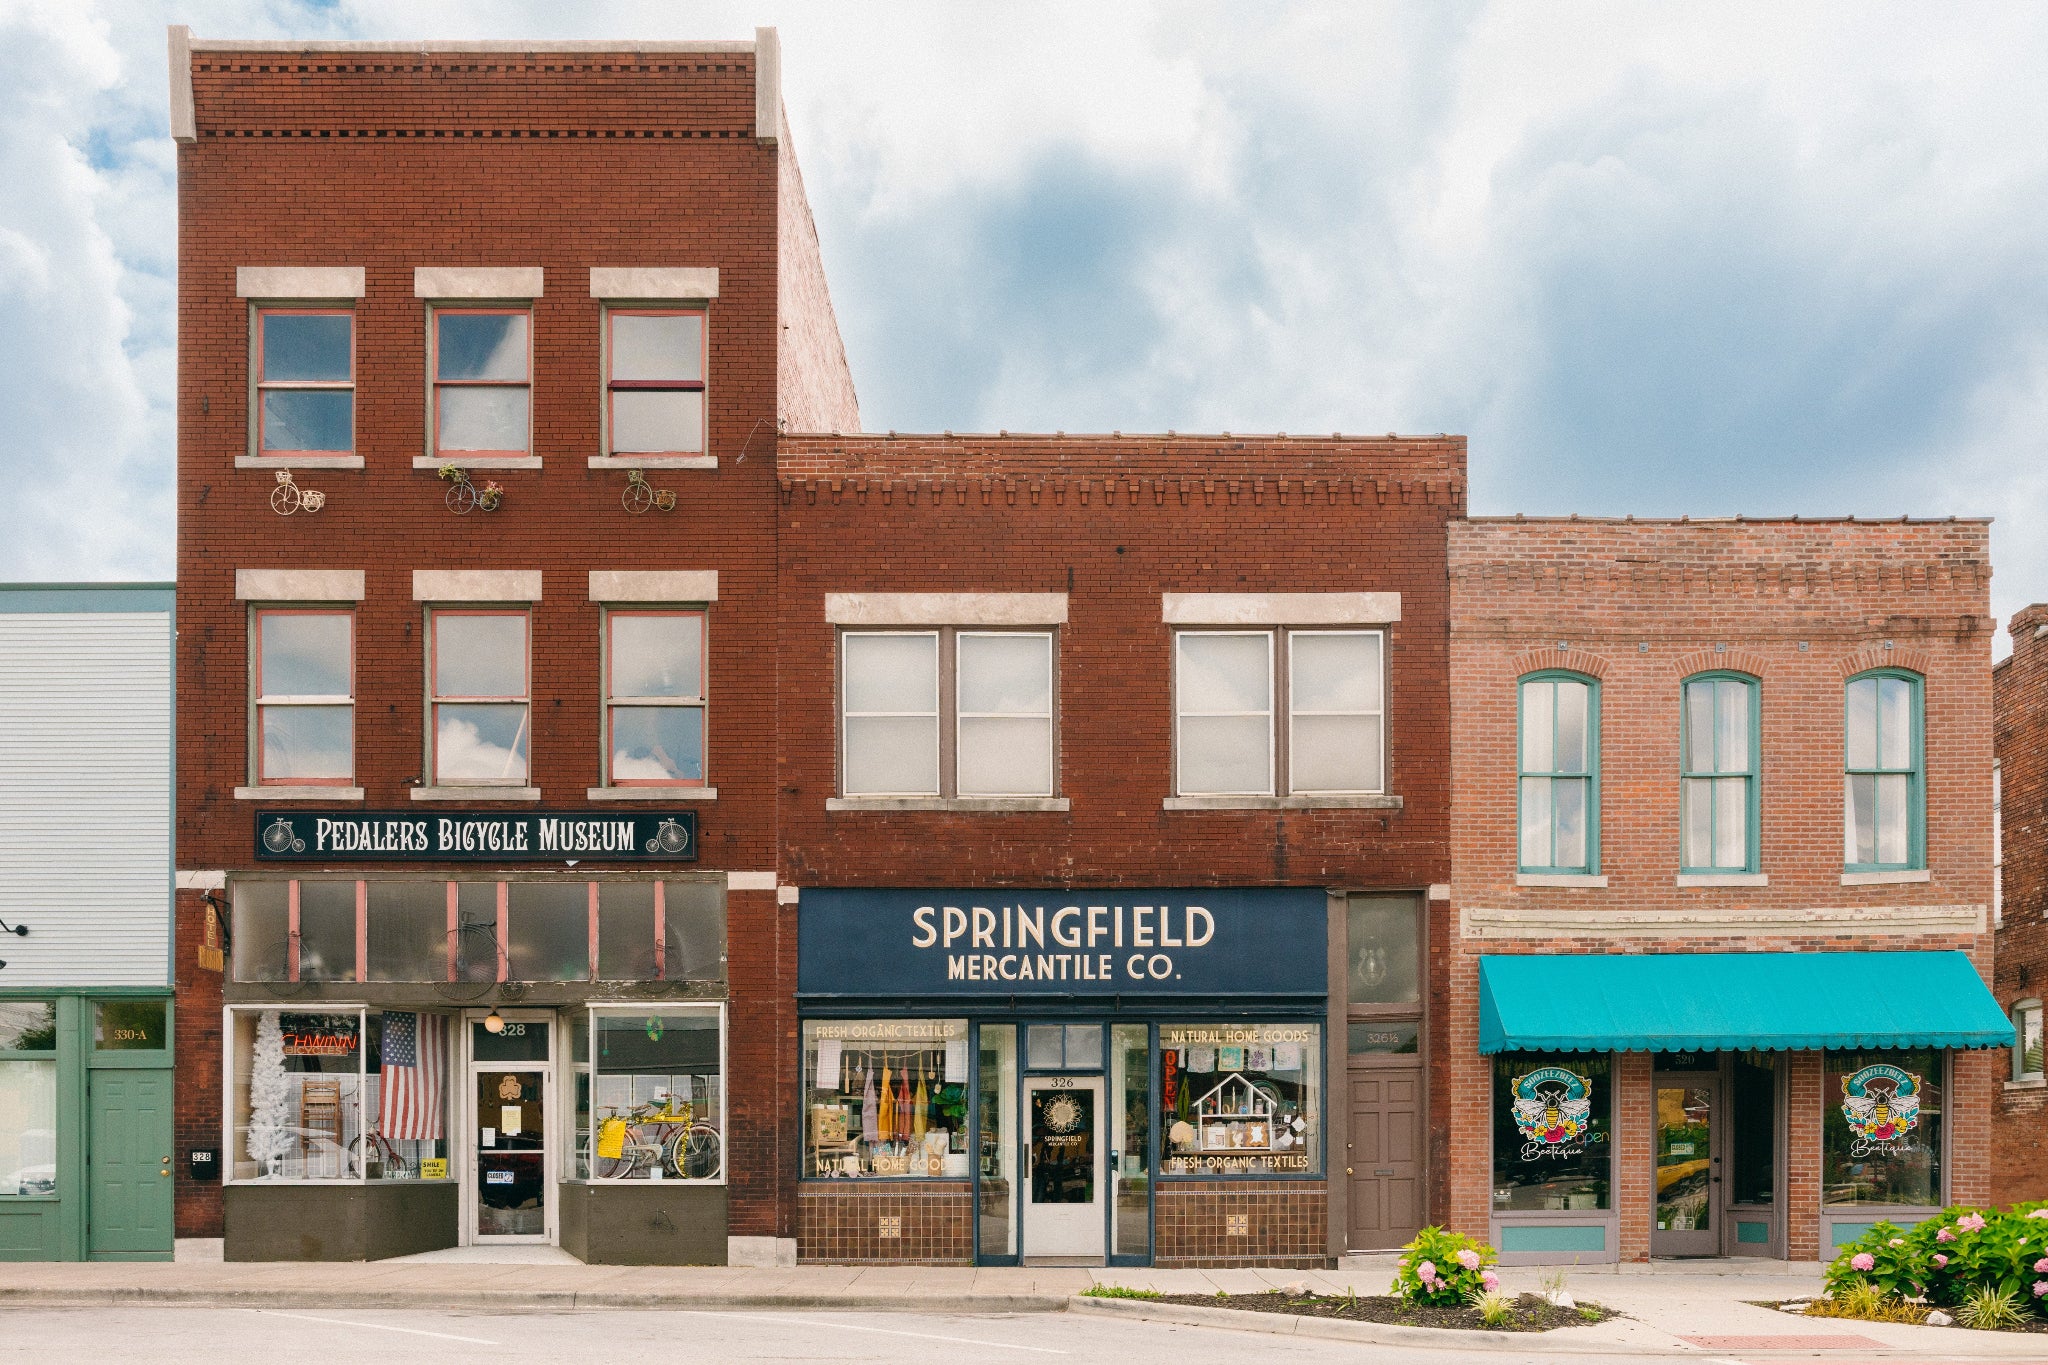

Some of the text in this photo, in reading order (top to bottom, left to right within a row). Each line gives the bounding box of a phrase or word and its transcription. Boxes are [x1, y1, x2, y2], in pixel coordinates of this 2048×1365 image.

[315, 818, 635, 852] PEDALERS BICYCLE MUSEUM
[206, 907, 216, 948] HOTEL
[912, 903, 1215, 950] SPRINGFIELD
[947, 953, 1182, 981] MERCANTILE CO.
[114, 1029, 147, 1040] 330-A
[498, 1023, 526, 1037] 328
[816, 1024, 955, 1038] FRESH ORGANIC TEXTILES
[1171, 1030, 1309, 1043] NATURAL HOME GOODS
[285, 1046, 343, 1055] BICYCLES
[1051, 1077, 1074, 1088] 326
[1163, 1049, 1178, 1112] OPEN
[1575, 1131, 1610, 1147] open
[193, 1152, 211, 1161] 328
[1520, 1141, 1583, 1162] Beetique
[816, 1159, 956, 1172] NATUAL HOME GOOD
[1171, 1155, 1309, 1169] FRESH ORGANIC TEXTILES
